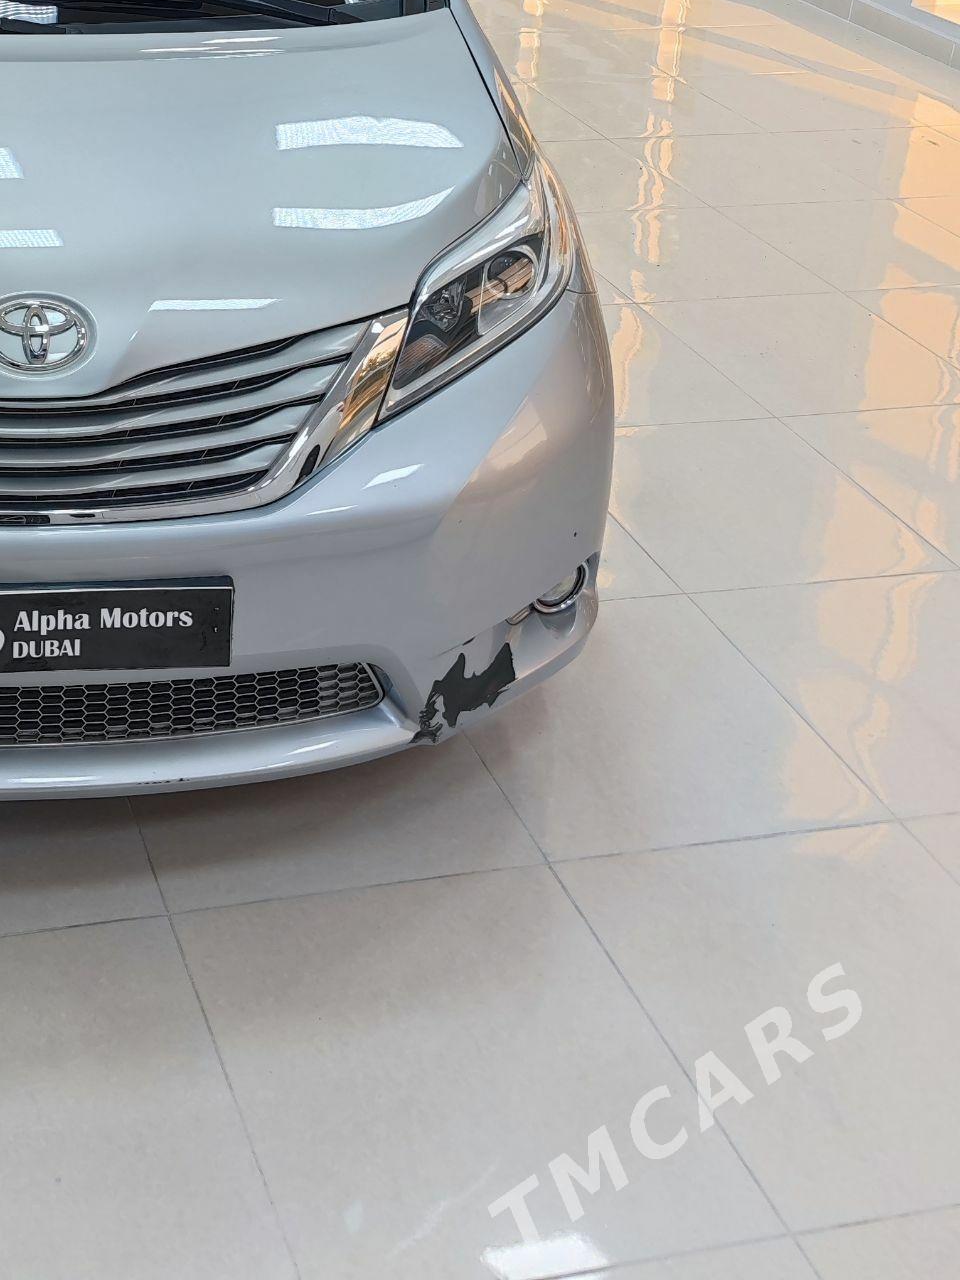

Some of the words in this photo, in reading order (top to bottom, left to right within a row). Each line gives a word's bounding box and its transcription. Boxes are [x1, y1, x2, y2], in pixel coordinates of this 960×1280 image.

[13, 608, 92, 635] Alpha
[100, 606, 194, 629] Motors
[12, 638, 82, 659] DUBAI
